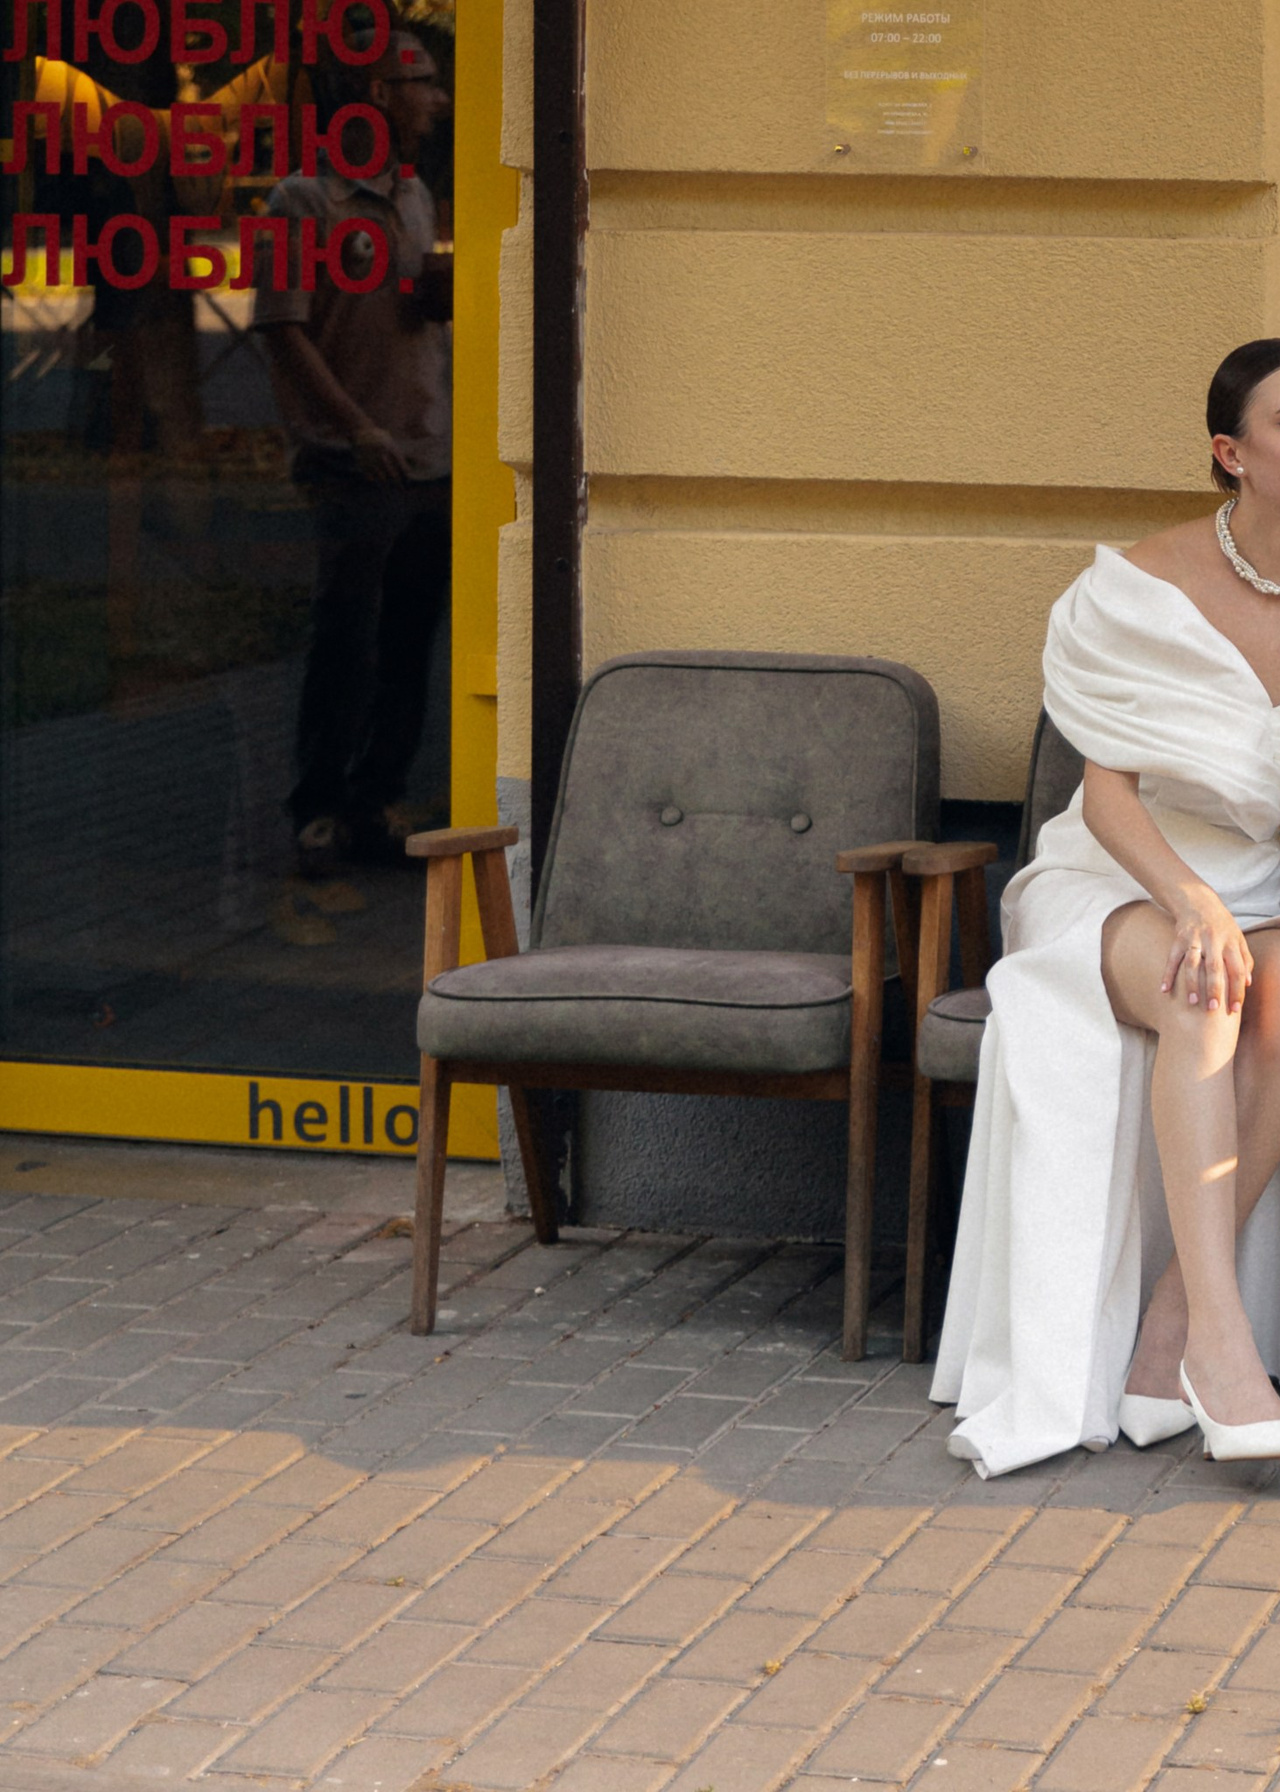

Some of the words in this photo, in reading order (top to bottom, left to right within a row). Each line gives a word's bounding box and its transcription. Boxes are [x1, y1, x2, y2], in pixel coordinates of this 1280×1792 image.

[861, 12, 904, 23] РЕЖИМ
[906, 13, 951, 24] РАБОТЫ
[870, 32, 901, 43] 07:00
[912, 33, 942, 44] 22:00
[2, 101, 415, 179] ЛЮБЛЮ.
[2, 213, 414, 294] ЛЮБЛЮ.
[249, 1081, 419, 1147] hello
